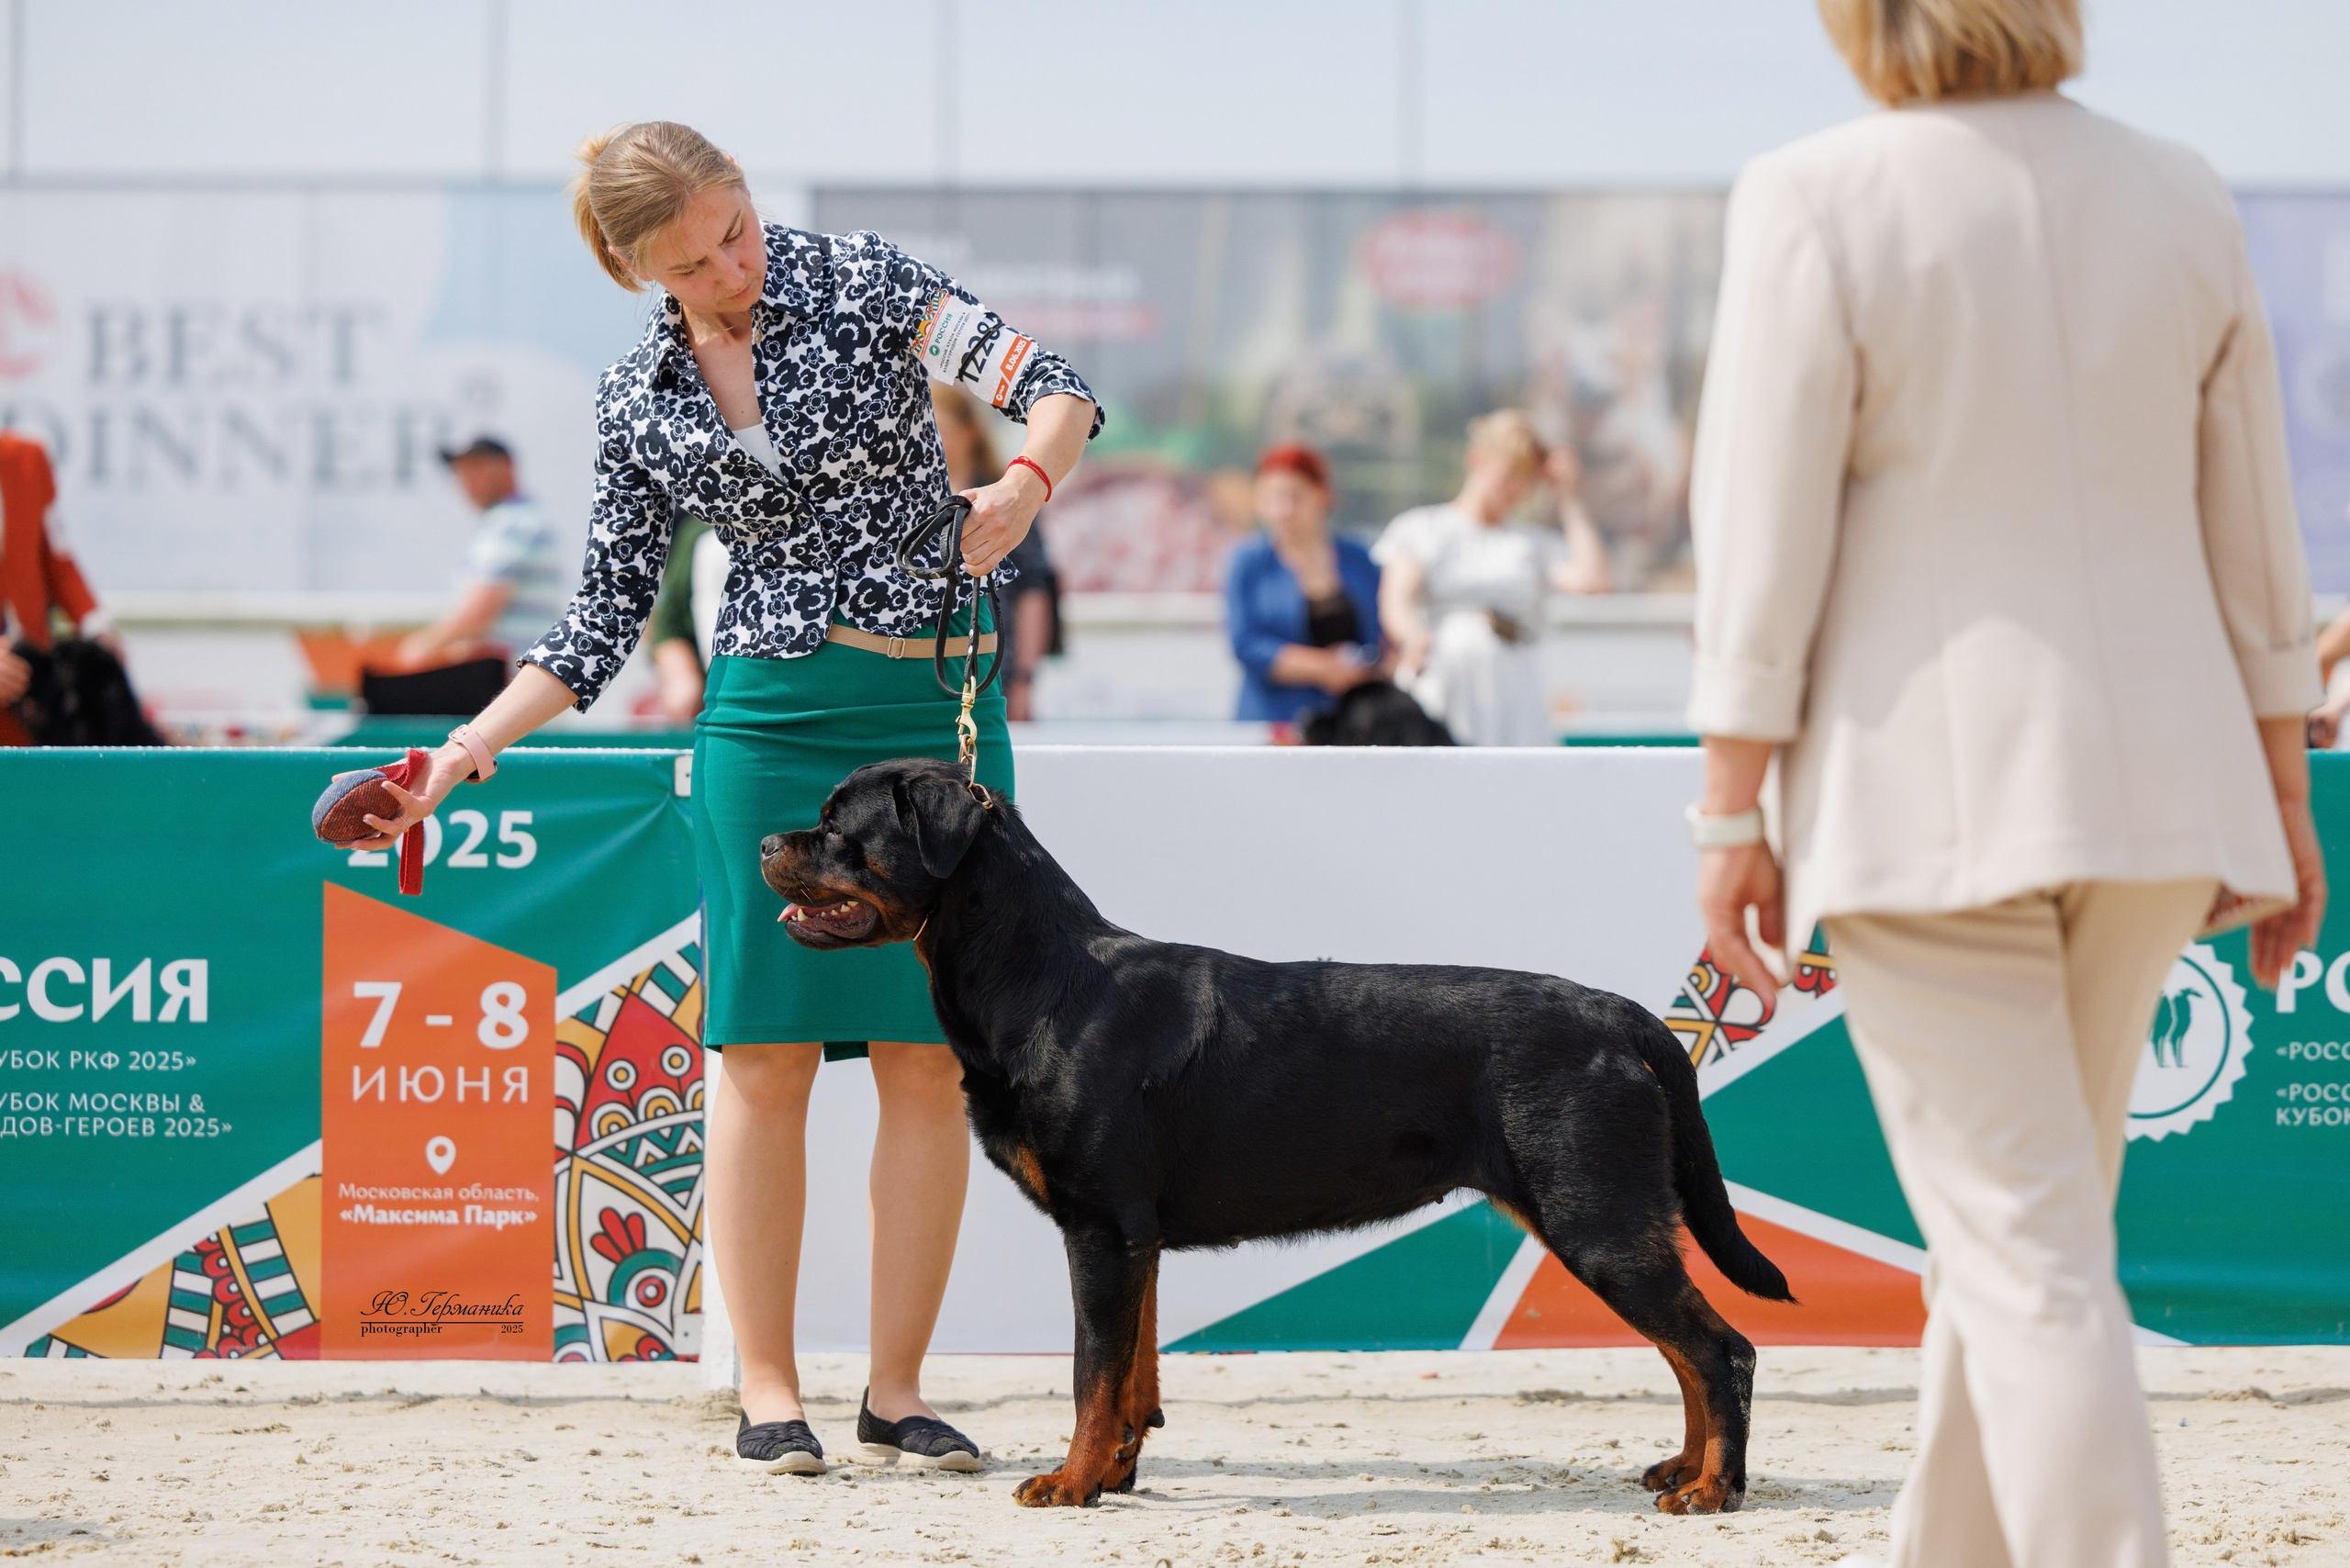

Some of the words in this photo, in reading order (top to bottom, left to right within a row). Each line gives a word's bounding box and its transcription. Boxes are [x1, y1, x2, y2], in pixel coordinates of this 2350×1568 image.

[84, 296, 390, 386] BEST
[934, 312, 953, 344] РОССИЯ
[1003, 338, 1027, 372] 8.06.2025
[353, 981, 402, 1047] 7
[477, 980, 529, 1049] 8
[70, 1050, 119, 1070] РКФ
[129, 1051, 196, 1070] 2025»
[352, 1065, 529, 1103] ИЮНЯ
[69, 1092, 180, 1113] МОСКВЫ
[188, 1093, 206, 1114] &
[163, 1117, 232, 1138] 2025»
[338, 1182, 453, 1201] Московская
[458, 1182, 539, 1203] область,
[340, 1204, 459, 1225] «Максима
[464, 1204, 538, 1231] Парк»
